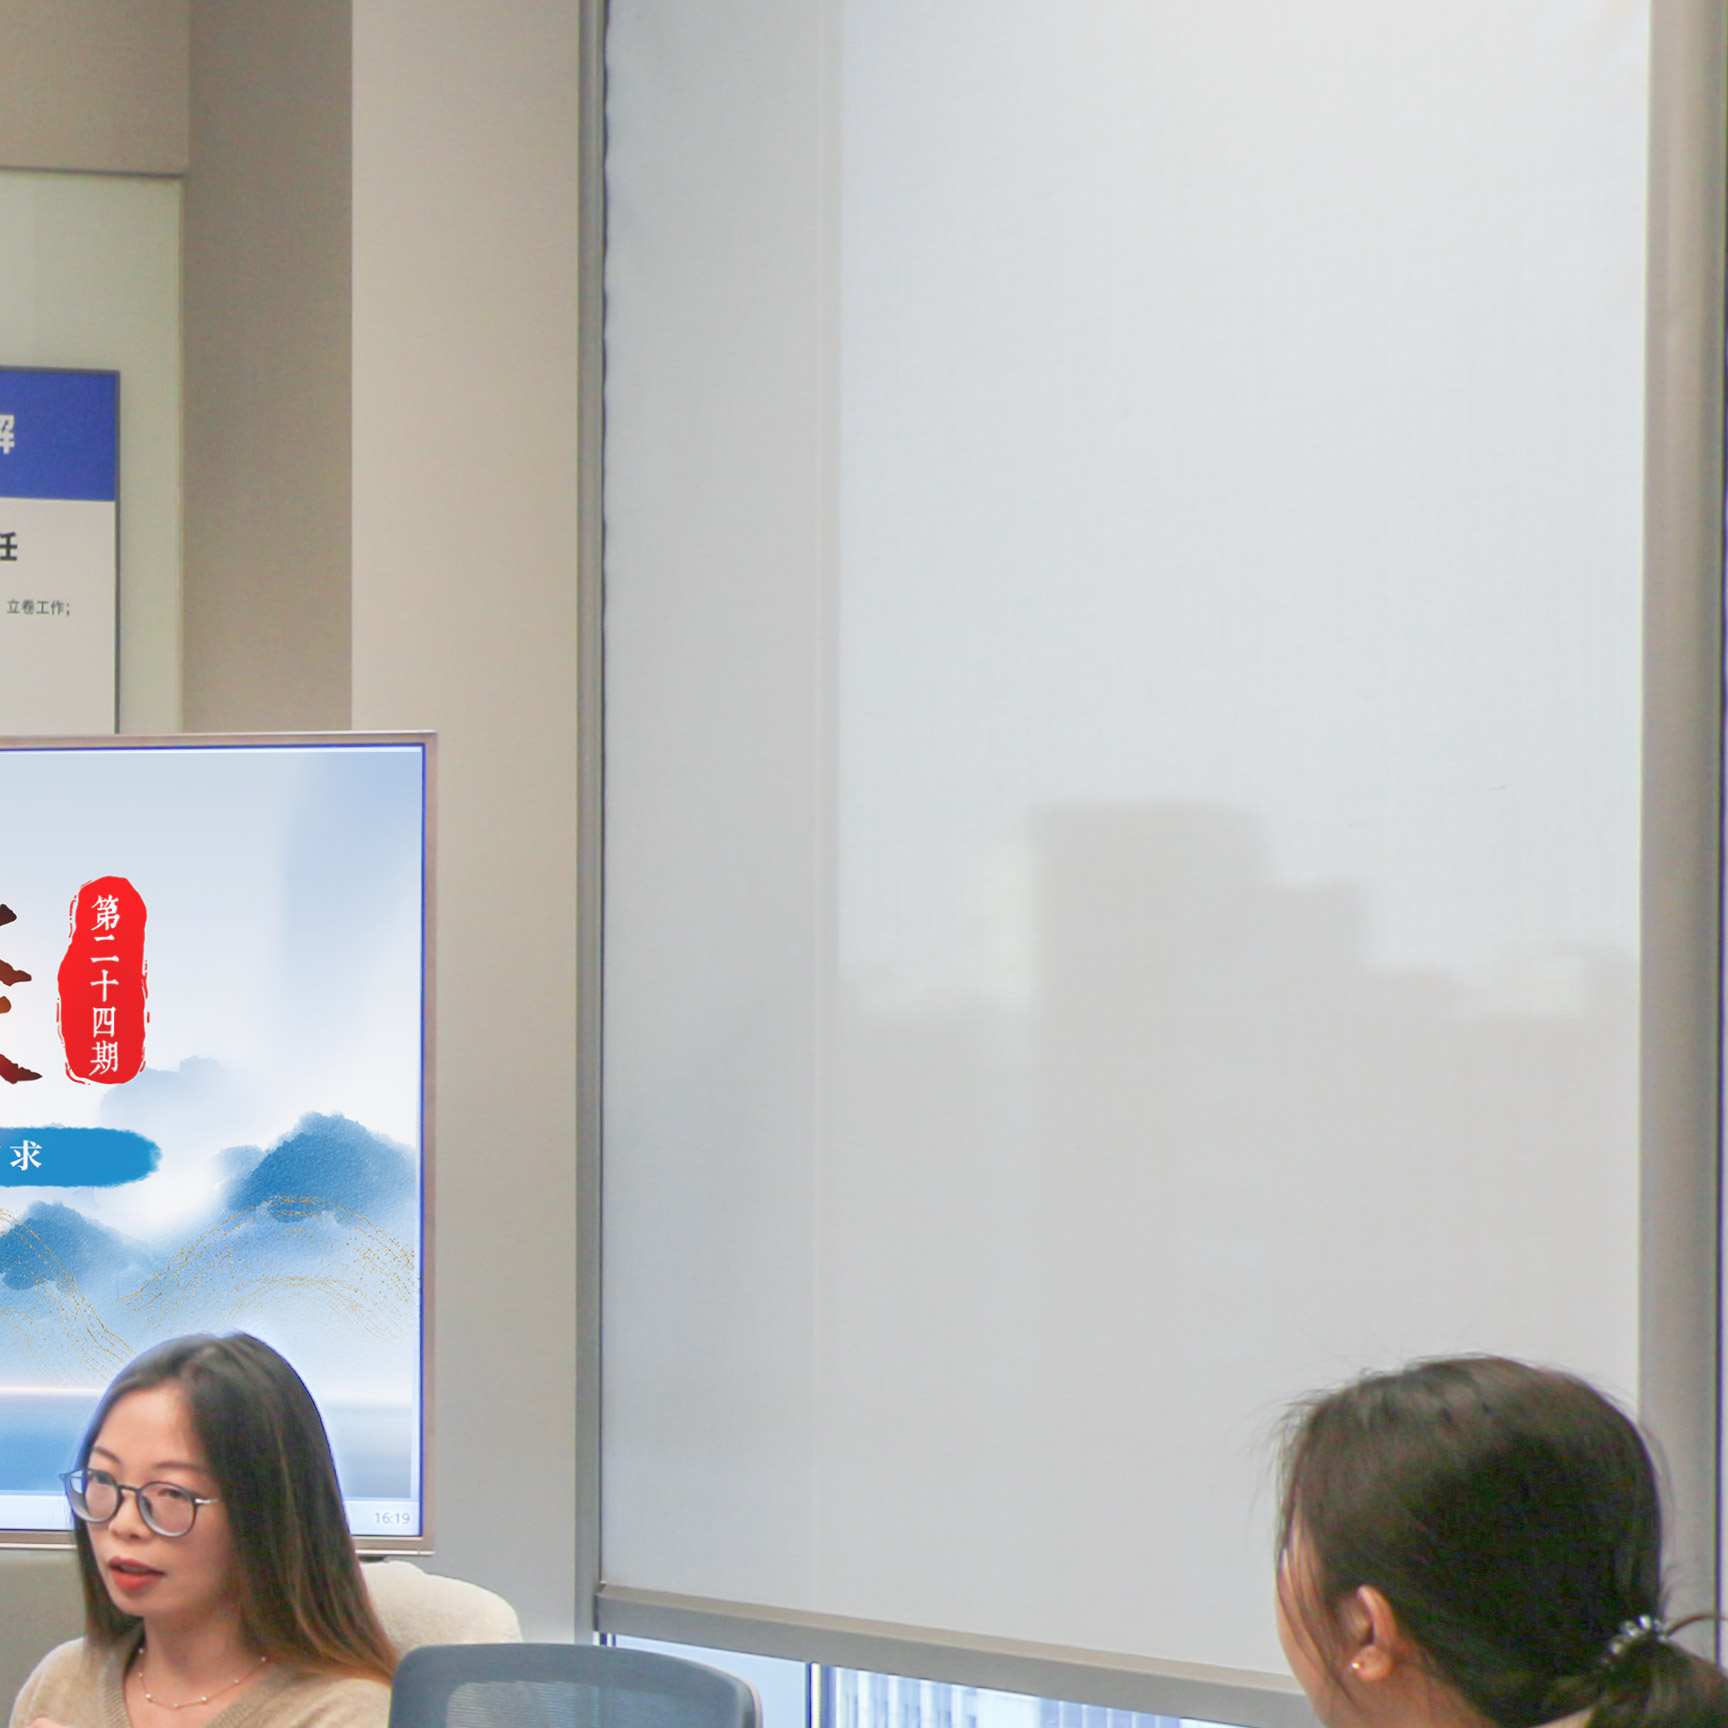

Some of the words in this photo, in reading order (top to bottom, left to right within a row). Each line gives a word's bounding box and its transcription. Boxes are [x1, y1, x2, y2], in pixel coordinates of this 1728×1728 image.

[88, 894, 121, 1077] 第二十四期
